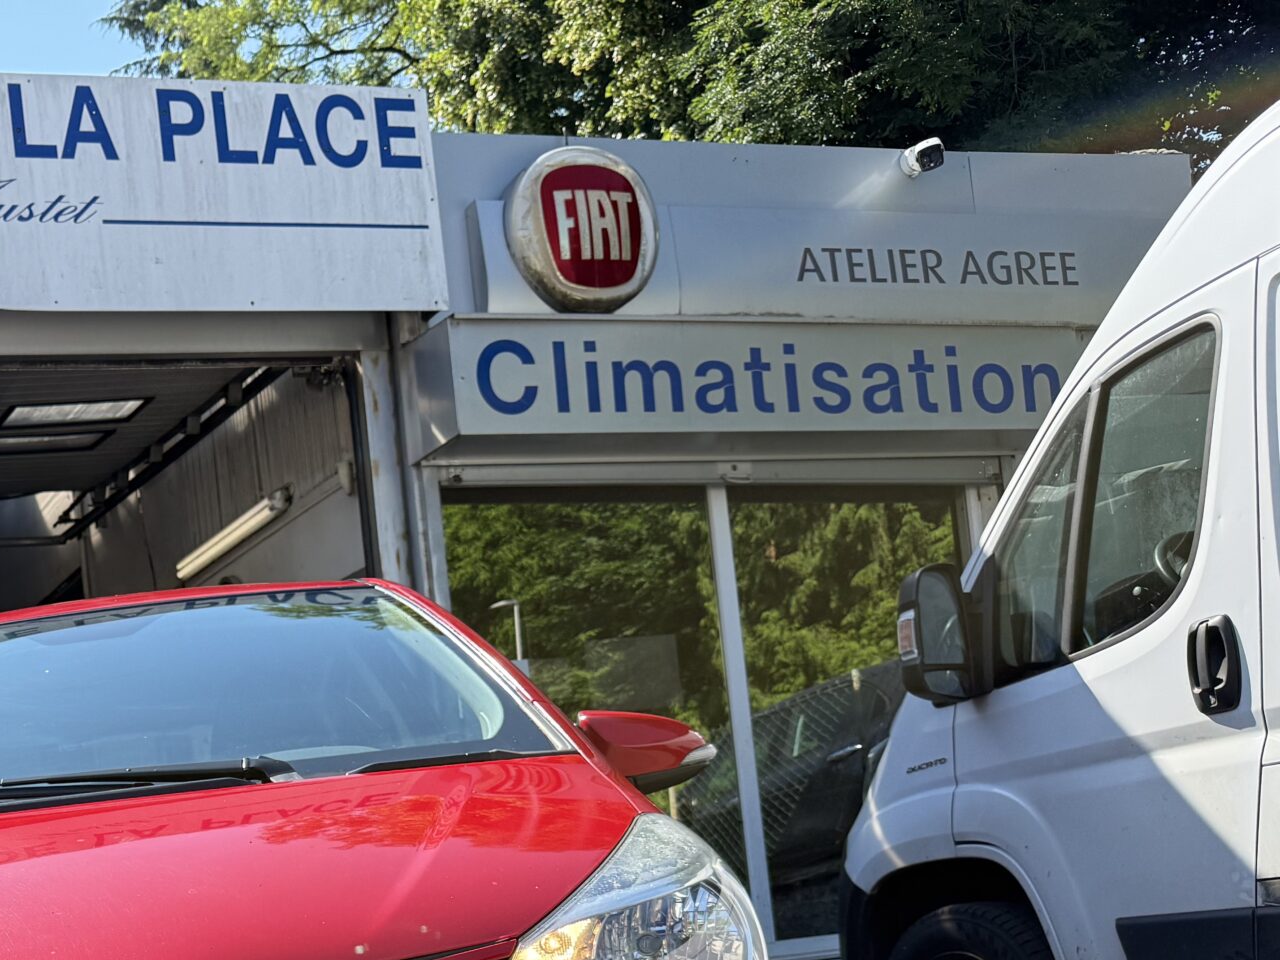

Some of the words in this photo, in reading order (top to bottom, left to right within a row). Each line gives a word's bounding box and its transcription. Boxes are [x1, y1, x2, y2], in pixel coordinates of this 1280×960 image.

[7, 83, 119, 160] LA
[156, 88, 423, 169] PLACE
[553, 189, 633, 261] FIAT
[797, 247, 946, 284] ATELIER
[960, 250, 1080, 286] AGREE
[476, 339, 1061, 416] Climatisation
